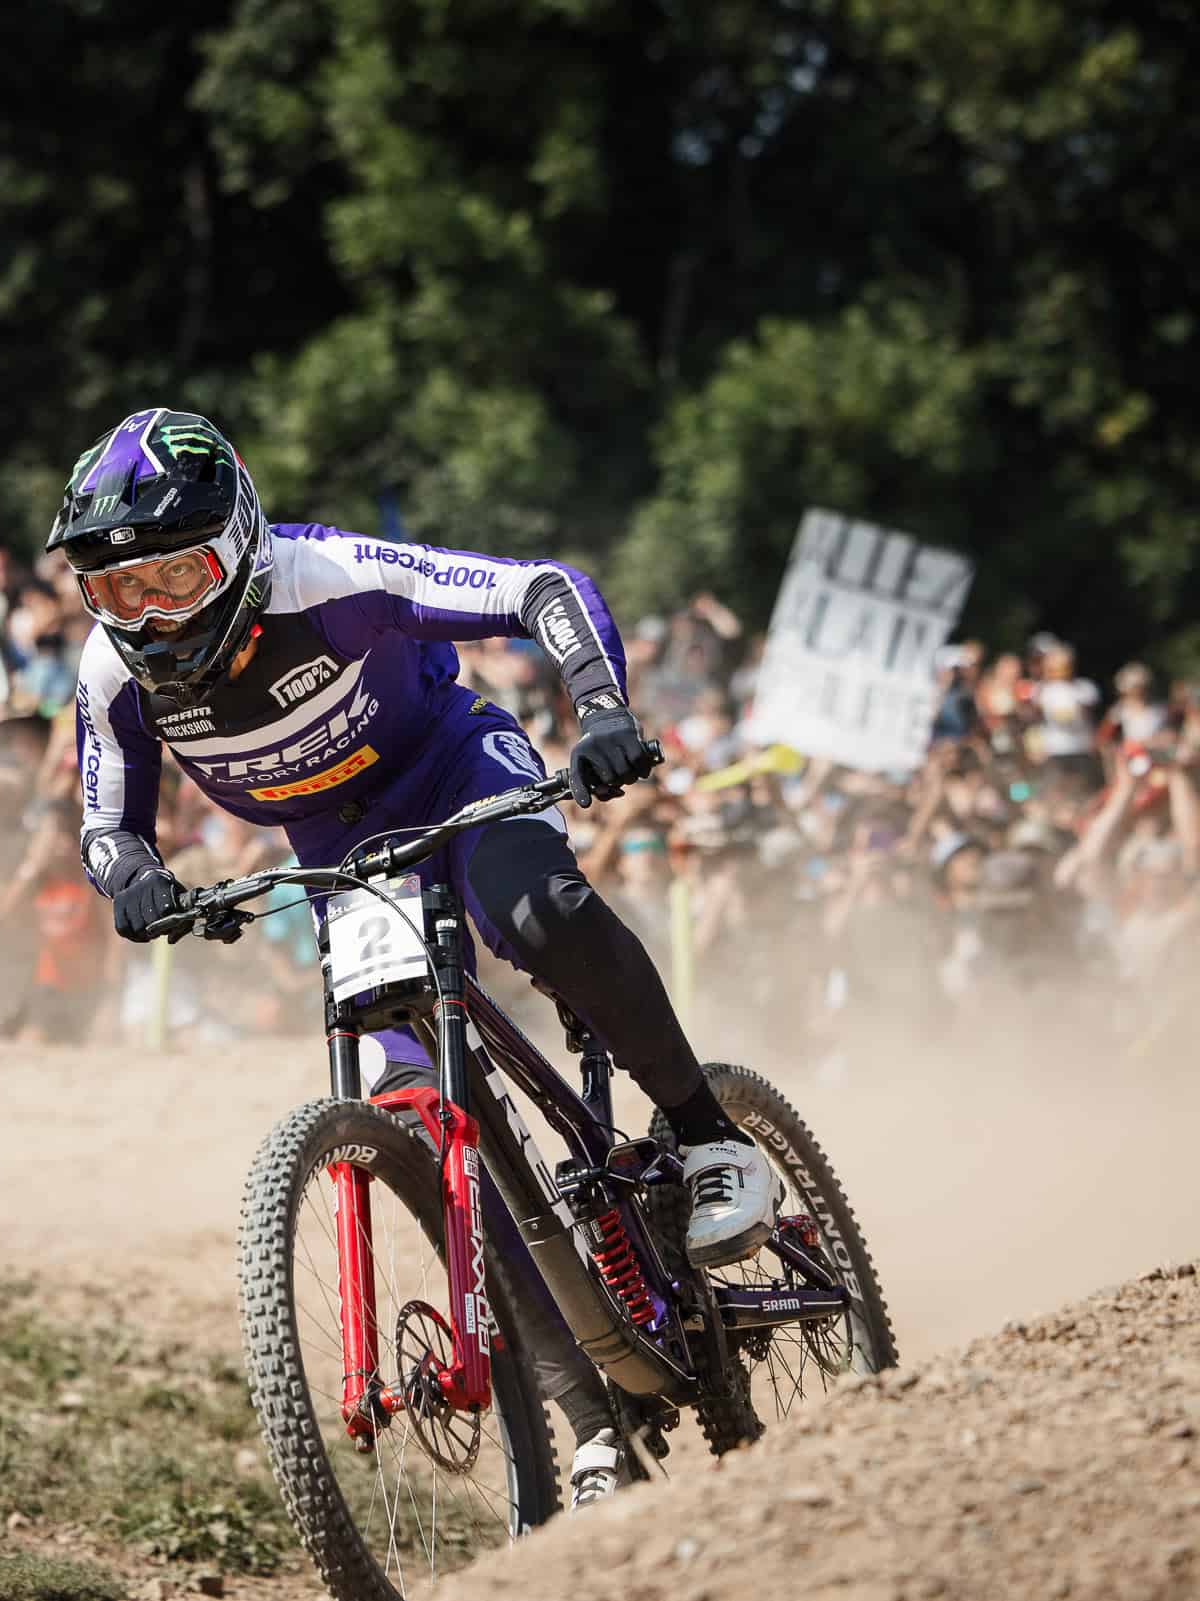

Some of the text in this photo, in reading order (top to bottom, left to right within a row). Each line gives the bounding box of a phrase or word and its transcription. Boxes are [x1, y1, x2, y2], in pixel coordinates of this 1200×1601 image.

[283, 663, 331, 703] 100%
[155, 706, 212, 725] SRAM
[305, 699, 380, 767] RACING
[358, 915, 393, 963] 2
[742, 1111, 864, 1301] BONTRAGER
[761, 1299, 801, 1313] SRAM
